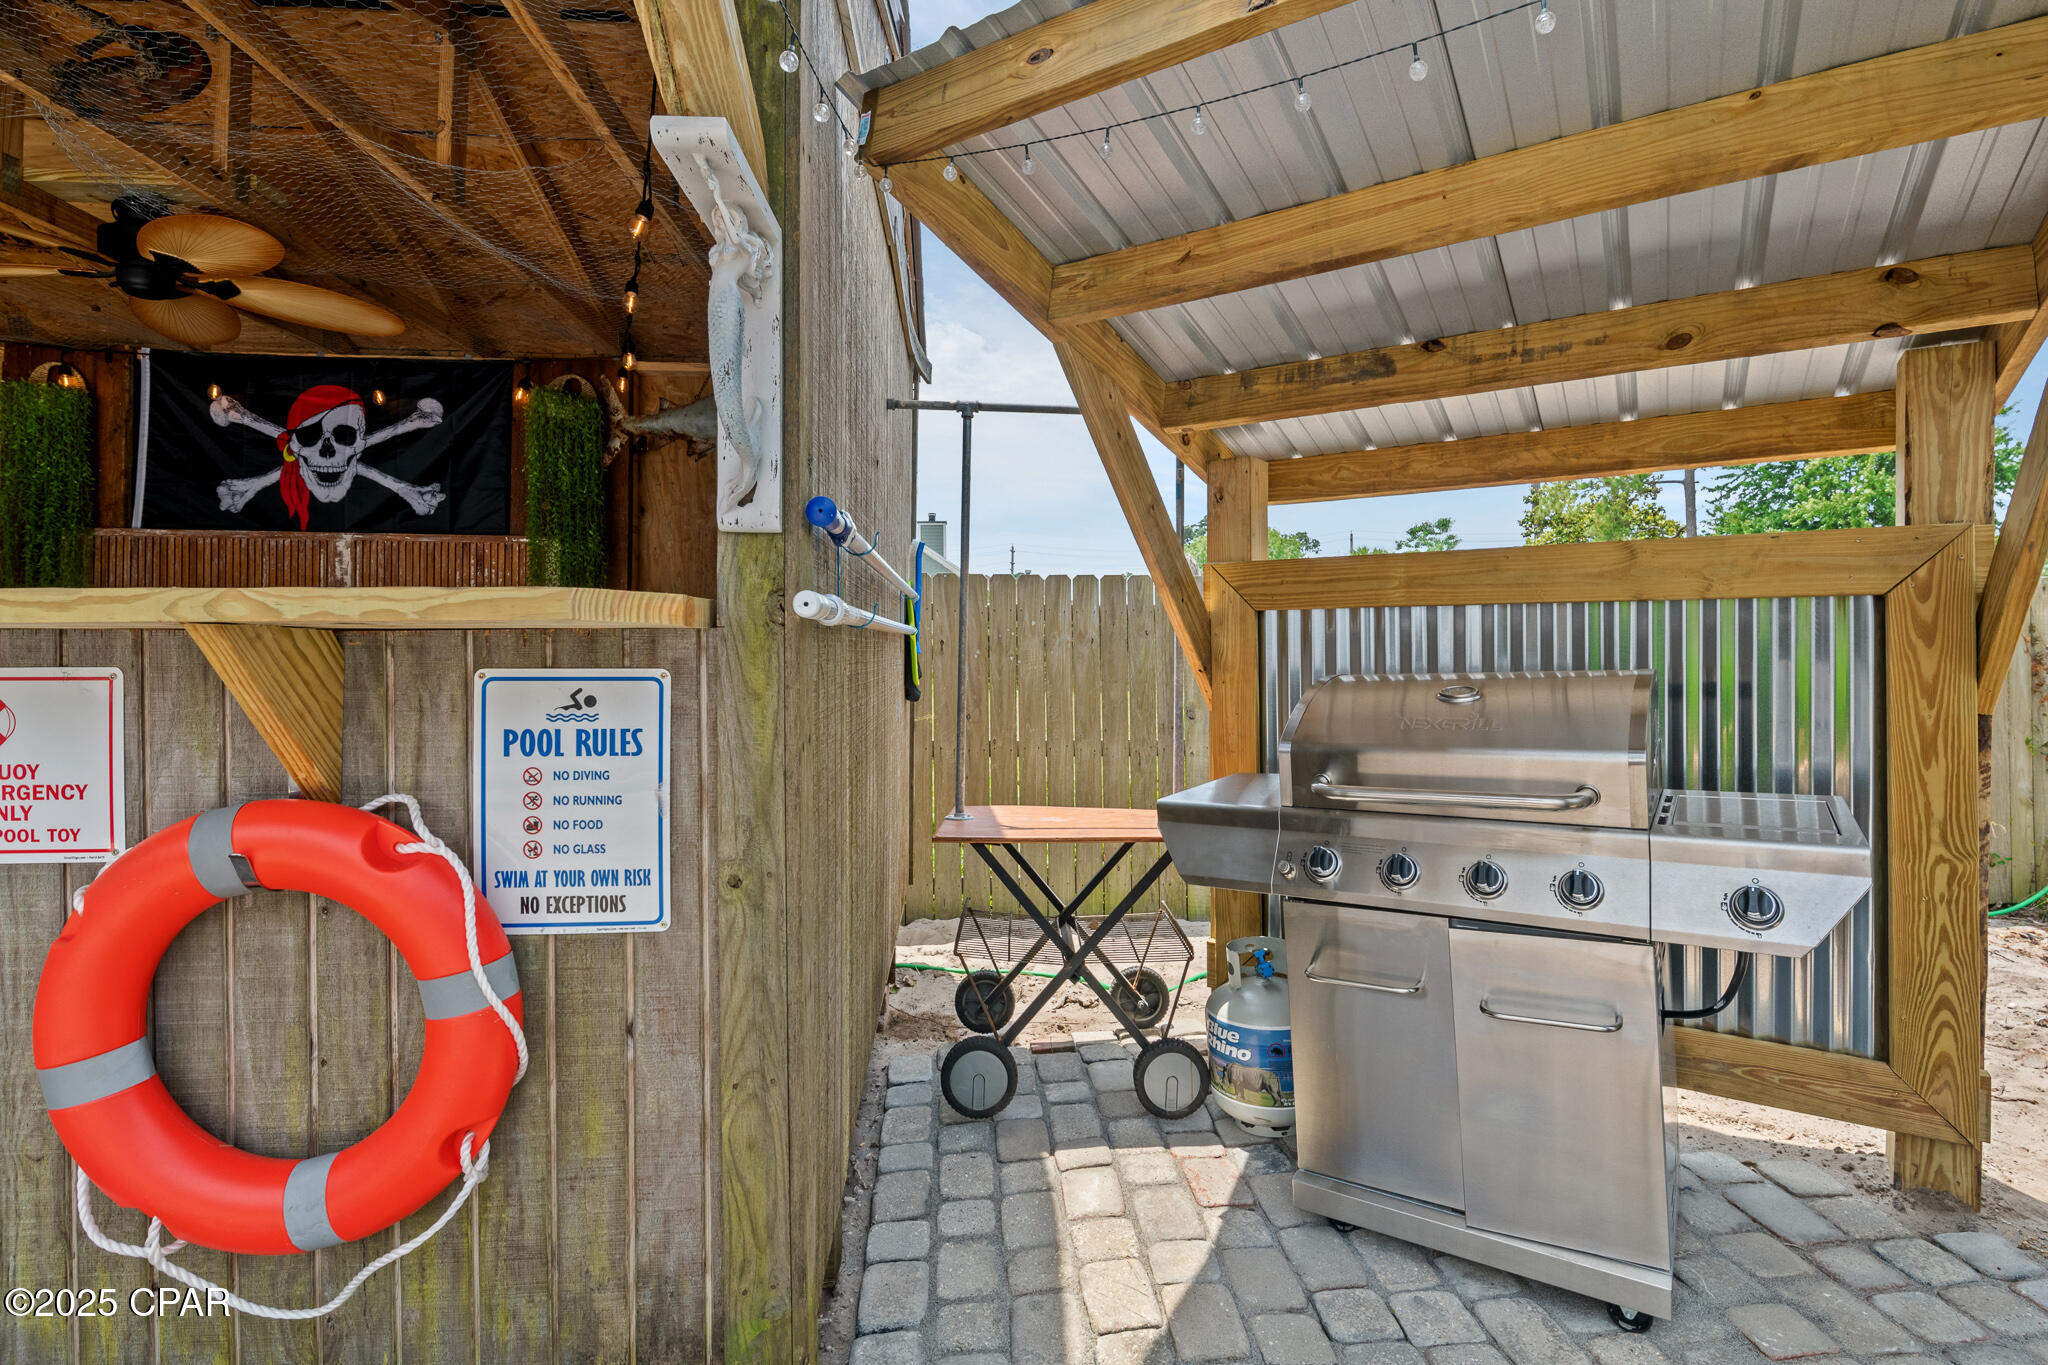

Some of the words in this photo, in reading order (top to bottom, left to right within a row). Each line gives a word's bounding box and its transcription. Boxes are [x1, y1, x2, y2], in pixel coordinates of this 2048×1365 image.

[503, 728, 564, 757] POOL
[575, 728, 643, 757] RULES
[553, 770, 570, 781] NO
[572, 770, 610, 781] DIVING
[553, 795, 570, 806] NO
[572, 795, 623, 806] RUNNING
[553, 820, 570, 831] NO
[572, 820, 603, 831] FOOD
[47, 828, 80, 842] TOY
[553, 844, 570, 855] NO
[572, 844, 606, 855] GLASS
[494, 870, 529, 889] SWIM
[534, 870, 548, 888] AT
[553, 869, 585, 887] YOUR
[590, 869, 619, 887] OWN
[624, 869, 651, 886] RISK
[520, 896, 540, 914] NO
[546, 895, 627, 914] EXCEPTIONS
[1207, 1019, 1240, 1043] Blue
